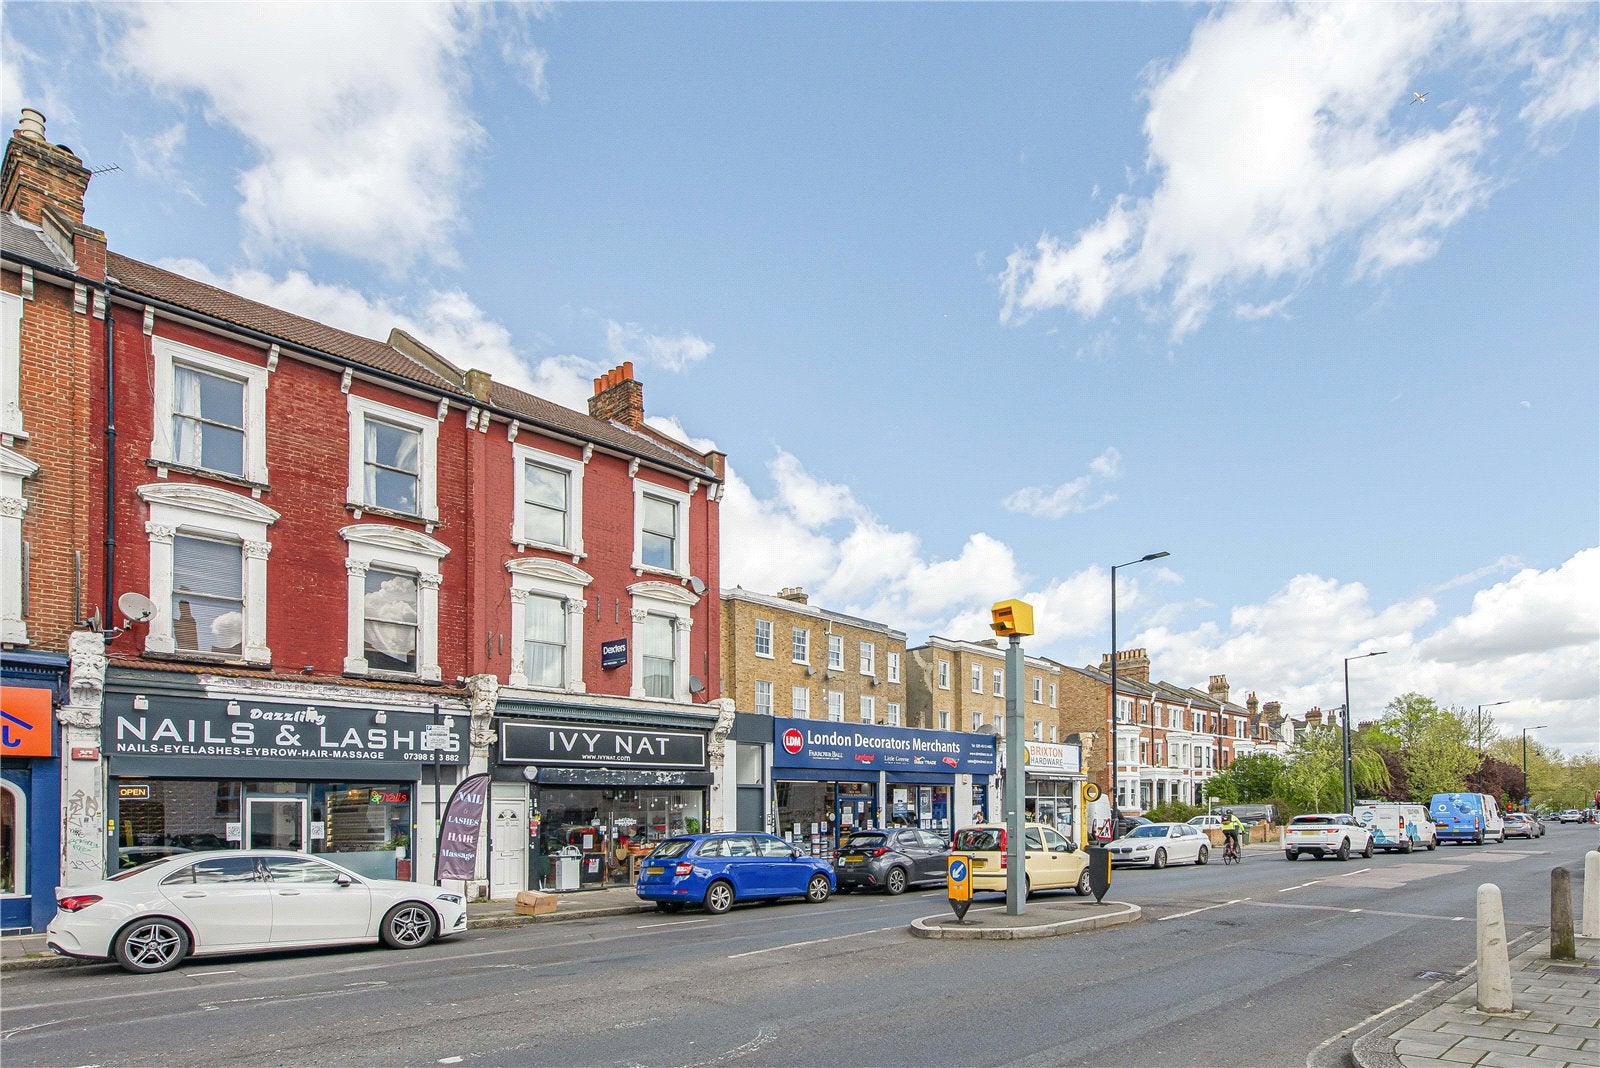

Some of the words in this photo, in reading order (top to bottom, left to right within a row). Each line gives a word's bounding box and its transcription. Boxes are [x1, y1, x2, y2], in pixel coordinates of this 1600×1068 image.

[603, 645, 626, 655] Dexters
[116, 715, 255, 745] NAILS
[275, 724, 302, 747] &
[549, 731, 601, 753] IVY
[615, 735, 670, 756] NAT
[785, 735, 802, 747] LDM
[807, 730, 852, 747] London
[854, 733, 911, 751] Decorators
[912, 737, 961, 754] Merchants
[404, 753, 427, 761] 07398
[429, 753, 444, 762] 53
[1030, 746, 1063, 758] BRIXTON
[1031, 757, 1063, 767] HARDWARE
[120, 788, 146, 797] OPEN
[448, 815, 480, 827] LASHES
[442, 848, 475, 861] Massage
